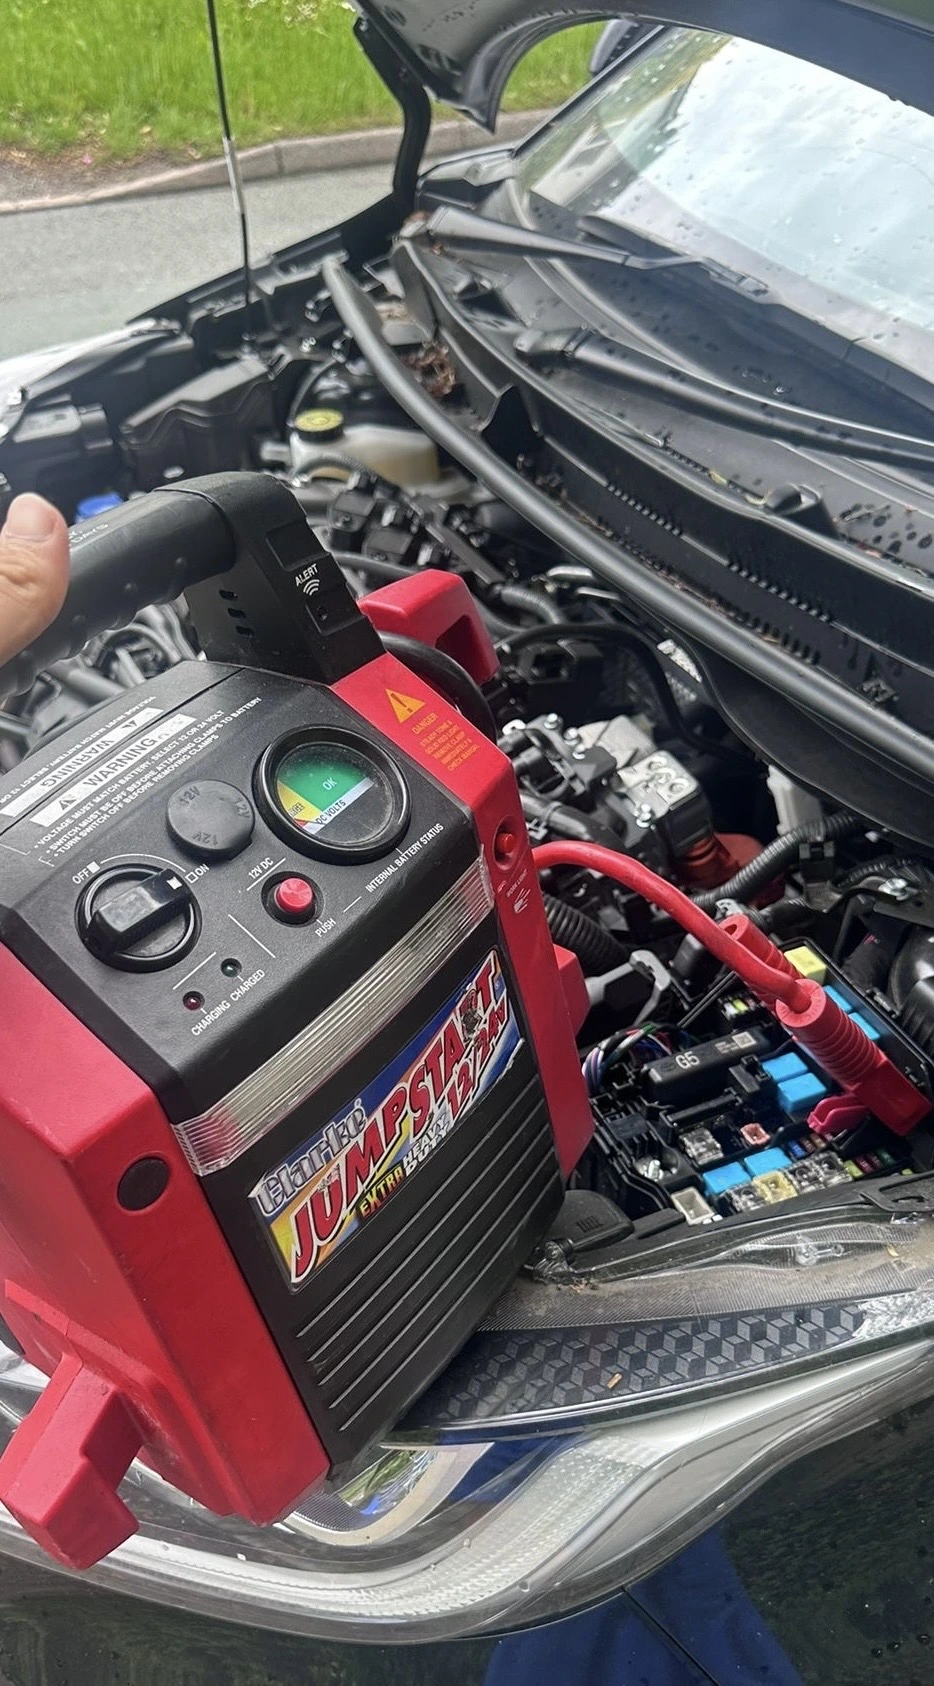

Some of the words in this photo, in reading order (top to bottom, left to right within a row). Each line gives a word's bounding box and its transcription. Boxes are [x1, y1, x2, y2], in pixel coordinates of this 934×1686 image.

[294, 563, 318, 587] ALERT
[411, 712, 438, 735] DANGER
[40, 739, 114, 787] WARNING
[49, 826, 80, 851] SWITCH
[79, 810, 102, 828] MUST
[99, 801, 114, 812] BE
[111, 790, 127, 803] OFF
[126, 770, 158, 792] BEFORE
[156, 743, 196, 771] ATTACHING
[193, 723, 223, 743] CLAMPS
[220, 716, 233, 724] TO
[230, 697, 262, 718] BATTERY
[82, 736, 157, 787] WARNING
[38, 818, 74, 845] VOLTAGE
[72, 802, 94, 820] MUST
[93, 783, 120, 803] MATCH
[151, 740, 179, 761] SELECT
[178, 734, 189, 742] 12
[186, 728, 200, 736] OR
[197, 721, 208, 729] 24
[205, 710, 224, 722] VOLT
[322, 776, 338, 790] OK
[56, 835, 82, 854] TURN
[79, 814, 111, 837] SWITCH
[108, 802, 124, 815] OFF
[123, 781, 155, 804] BEFORE
[151, 754, 191, 782] REMOVING
[188, 733, 219, 755] CLAMPS
[179, 785, 200, 806] 12V
[316, 815, 327, 826] DC
[325, 800, 347, 818] VOLTS
[191, 831, 218, 846] 12V
[196, 863, 210, 877] ON
[248, 865, 264, 880] 12V
[260, 857, 274, 870] DC
[365, 862, 399, 893] INTERNAL
[395, 841, 423, 868] BATTERY
[419, 822, 444, 846] STATUS
[72, 868, 90, 885] OFF
[314, 918, 337, 938] PUSH
[230, 969, 266, 1001] CHARGED
[190, 1000, 231, 1036] CHARGING
[675, 1051, 700, 1069] G5
[257, 1105, 367, 1217] Clarke
[405, 1122, 450, 1177] DUTY
[359, 1165, 406, 1217] EXTRA
[402, 1113, 447, 1169] HEAVY
